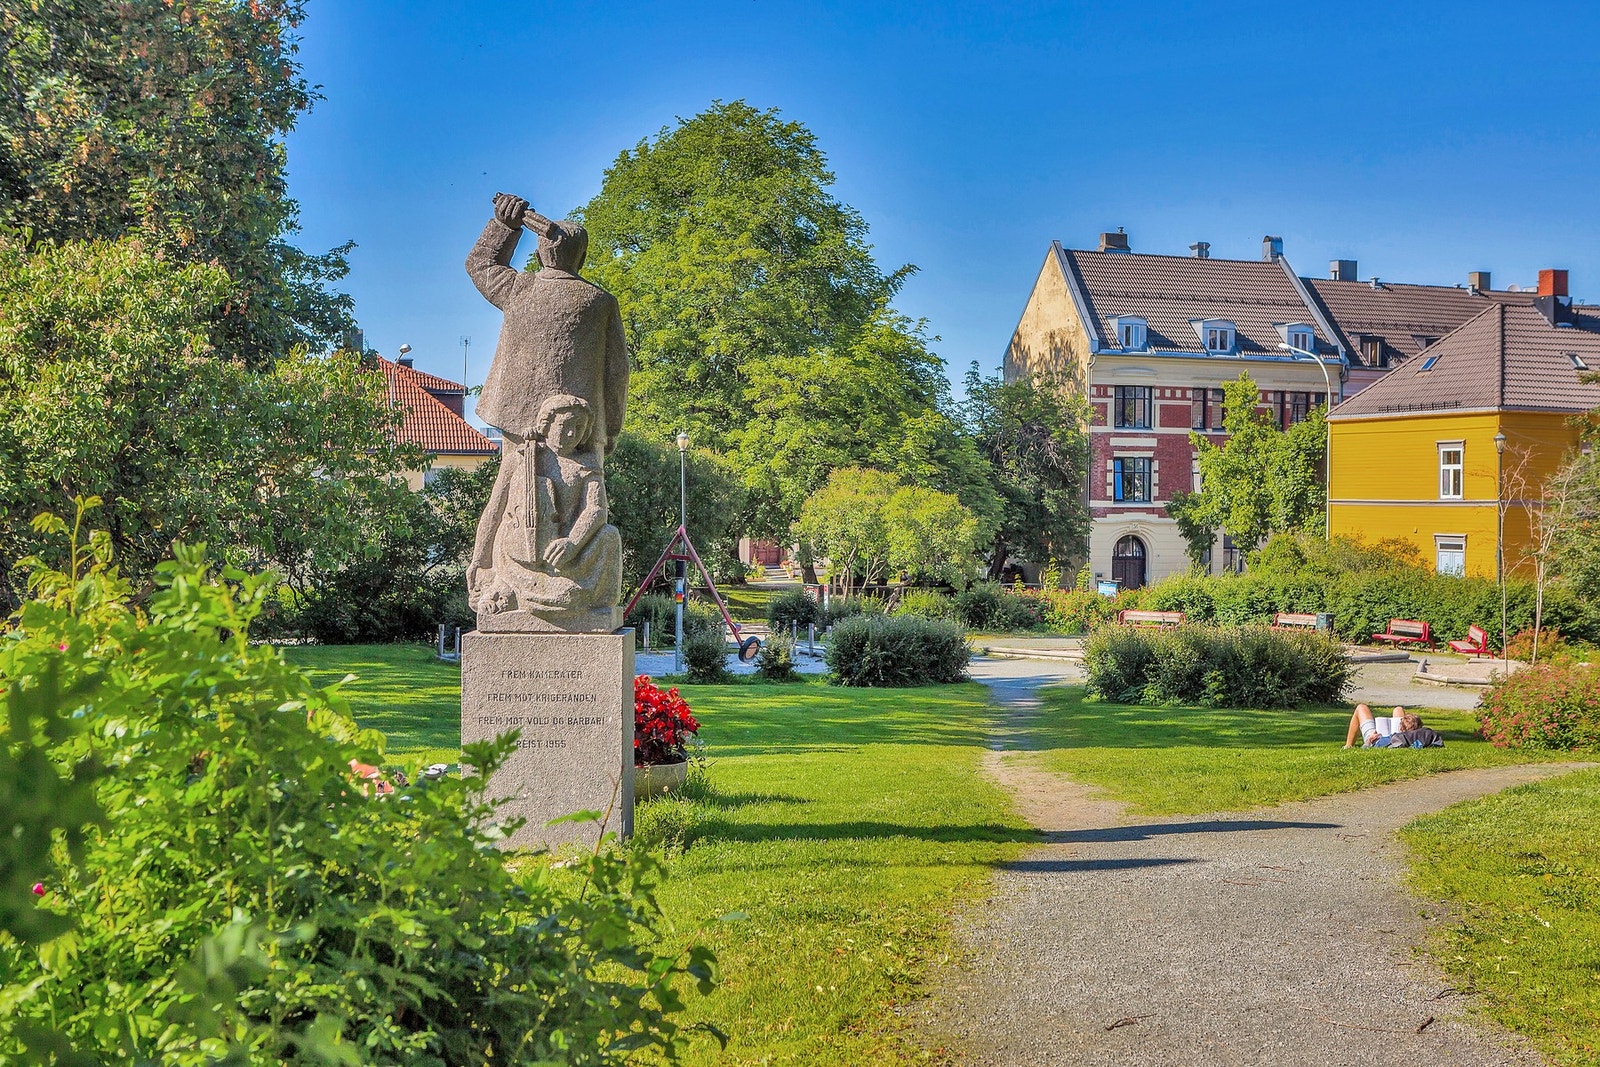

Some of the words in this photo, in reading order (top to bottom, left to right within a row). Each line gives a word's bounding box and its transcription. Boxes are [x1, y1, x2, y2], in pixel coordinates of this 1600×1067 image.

[501, 669, 527, 680] FREM
[487, 693, 513, 703] FREM
[478, 716, 503, 726] FREM
[527, 716, 550, 726] VOLD
[552, 716, 565, 726] OG
[567, 716, 605, 726] BARBARI
[515, 739, 543, 749] REIST
[545, 739, 567, 749] 1955
